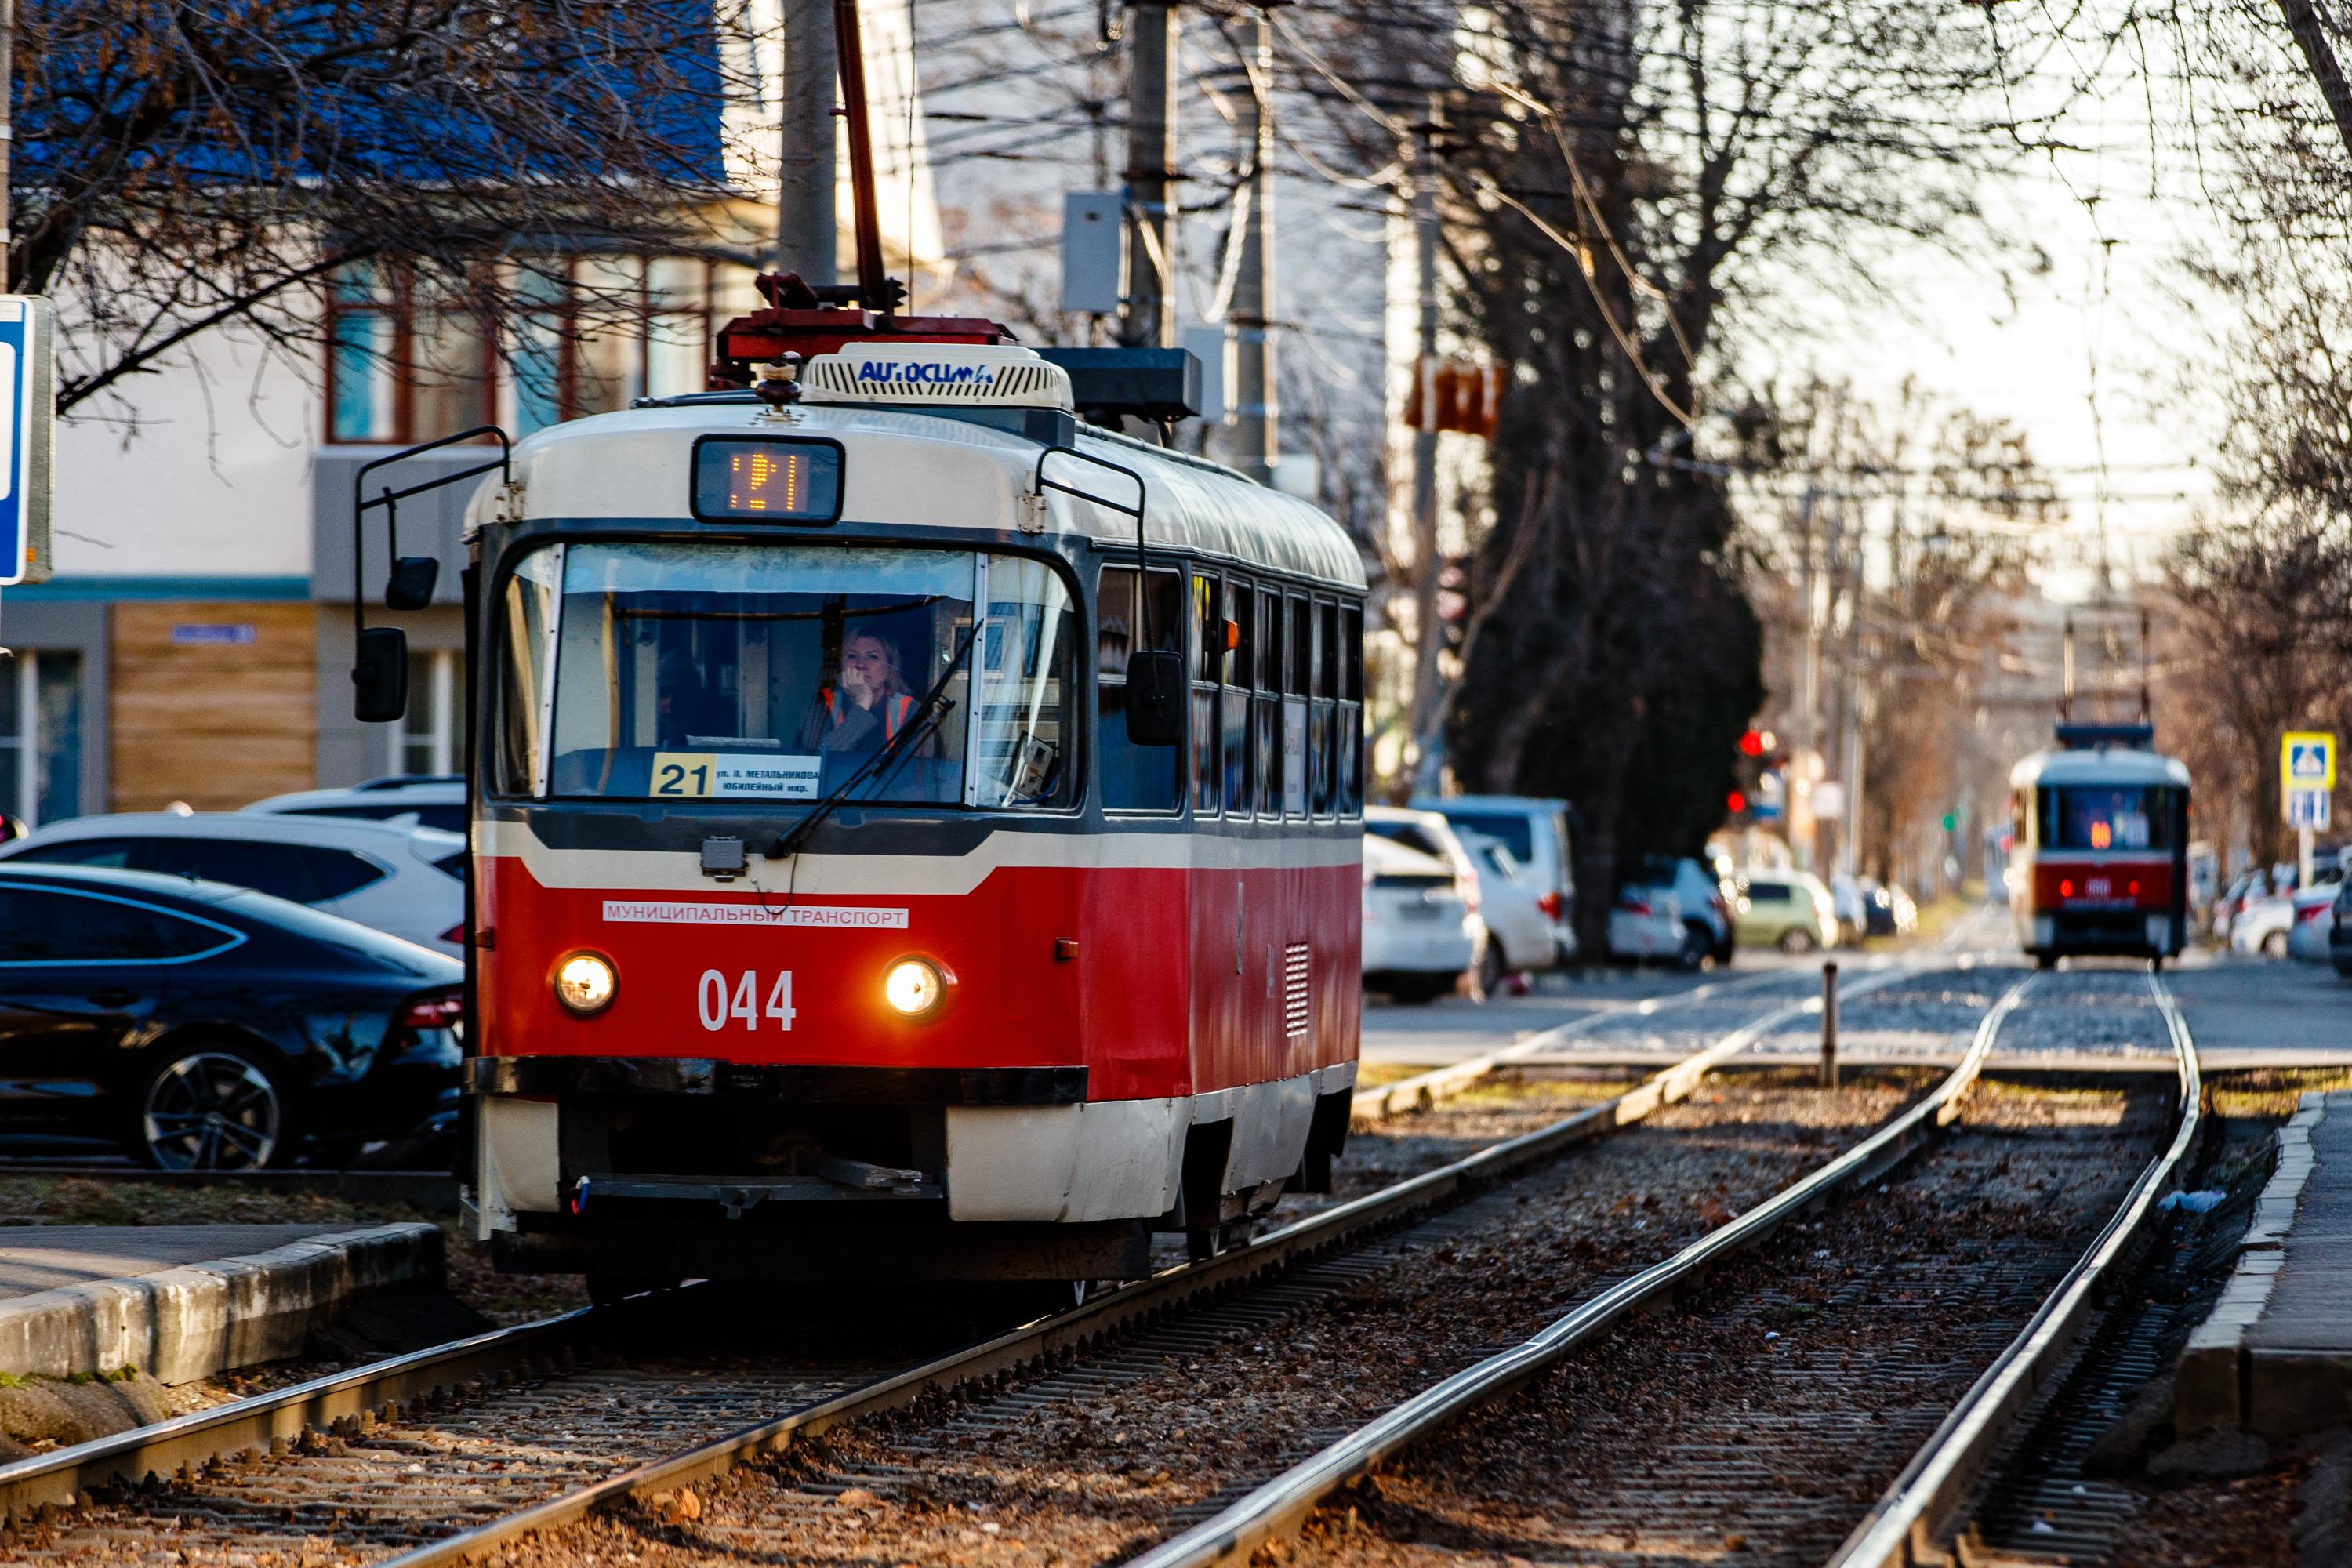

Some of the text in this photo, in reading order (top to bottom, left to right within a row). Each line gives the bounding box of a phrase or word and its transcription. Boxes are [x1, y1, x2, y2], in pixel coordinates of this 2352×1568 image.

[659, 764, 708, 796] 21
[746, 770, 818, 779] МЕТАЛЬНИКОВА
[723, 782, 809, 793] ЮБИЛЕЙНЫЙ мкр.
[607, 905, 903, 926] МУНИЦИПАЛЬНЫЙ ТРАНСПОРТ
[698, 969, 797, 1031] 044
